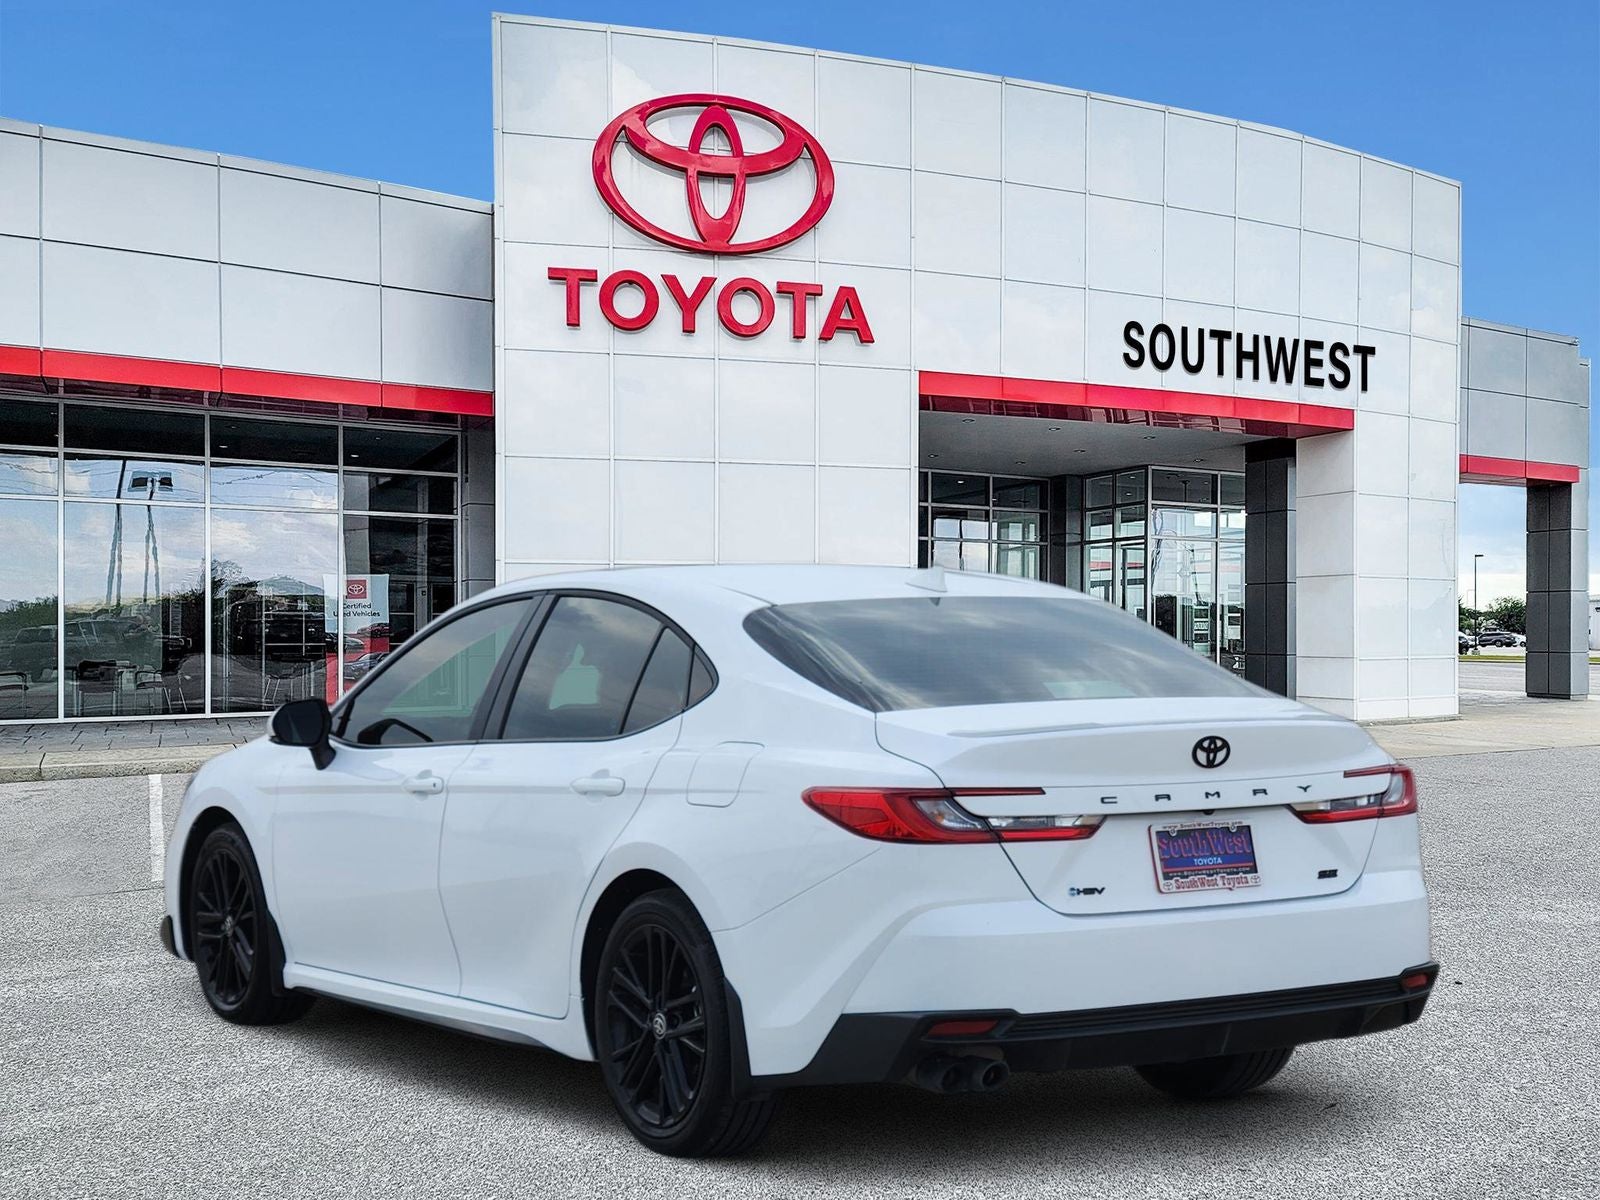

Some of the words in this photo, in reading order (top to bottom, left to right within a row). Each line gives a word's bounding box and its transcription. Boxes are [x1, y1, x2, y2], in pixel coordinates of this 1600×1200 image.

[548, 266, 875, 344] TOYOTA
[1122, 320, 1376, 392] SOUTHWEST
[1100, 784, 1312, 805] CAMRY
[1193, 857, 1223, 866] TOYOTA
[1174, 876, 1219, 890] SouthWest
[1220, 874, 1249, 889] Toyota
